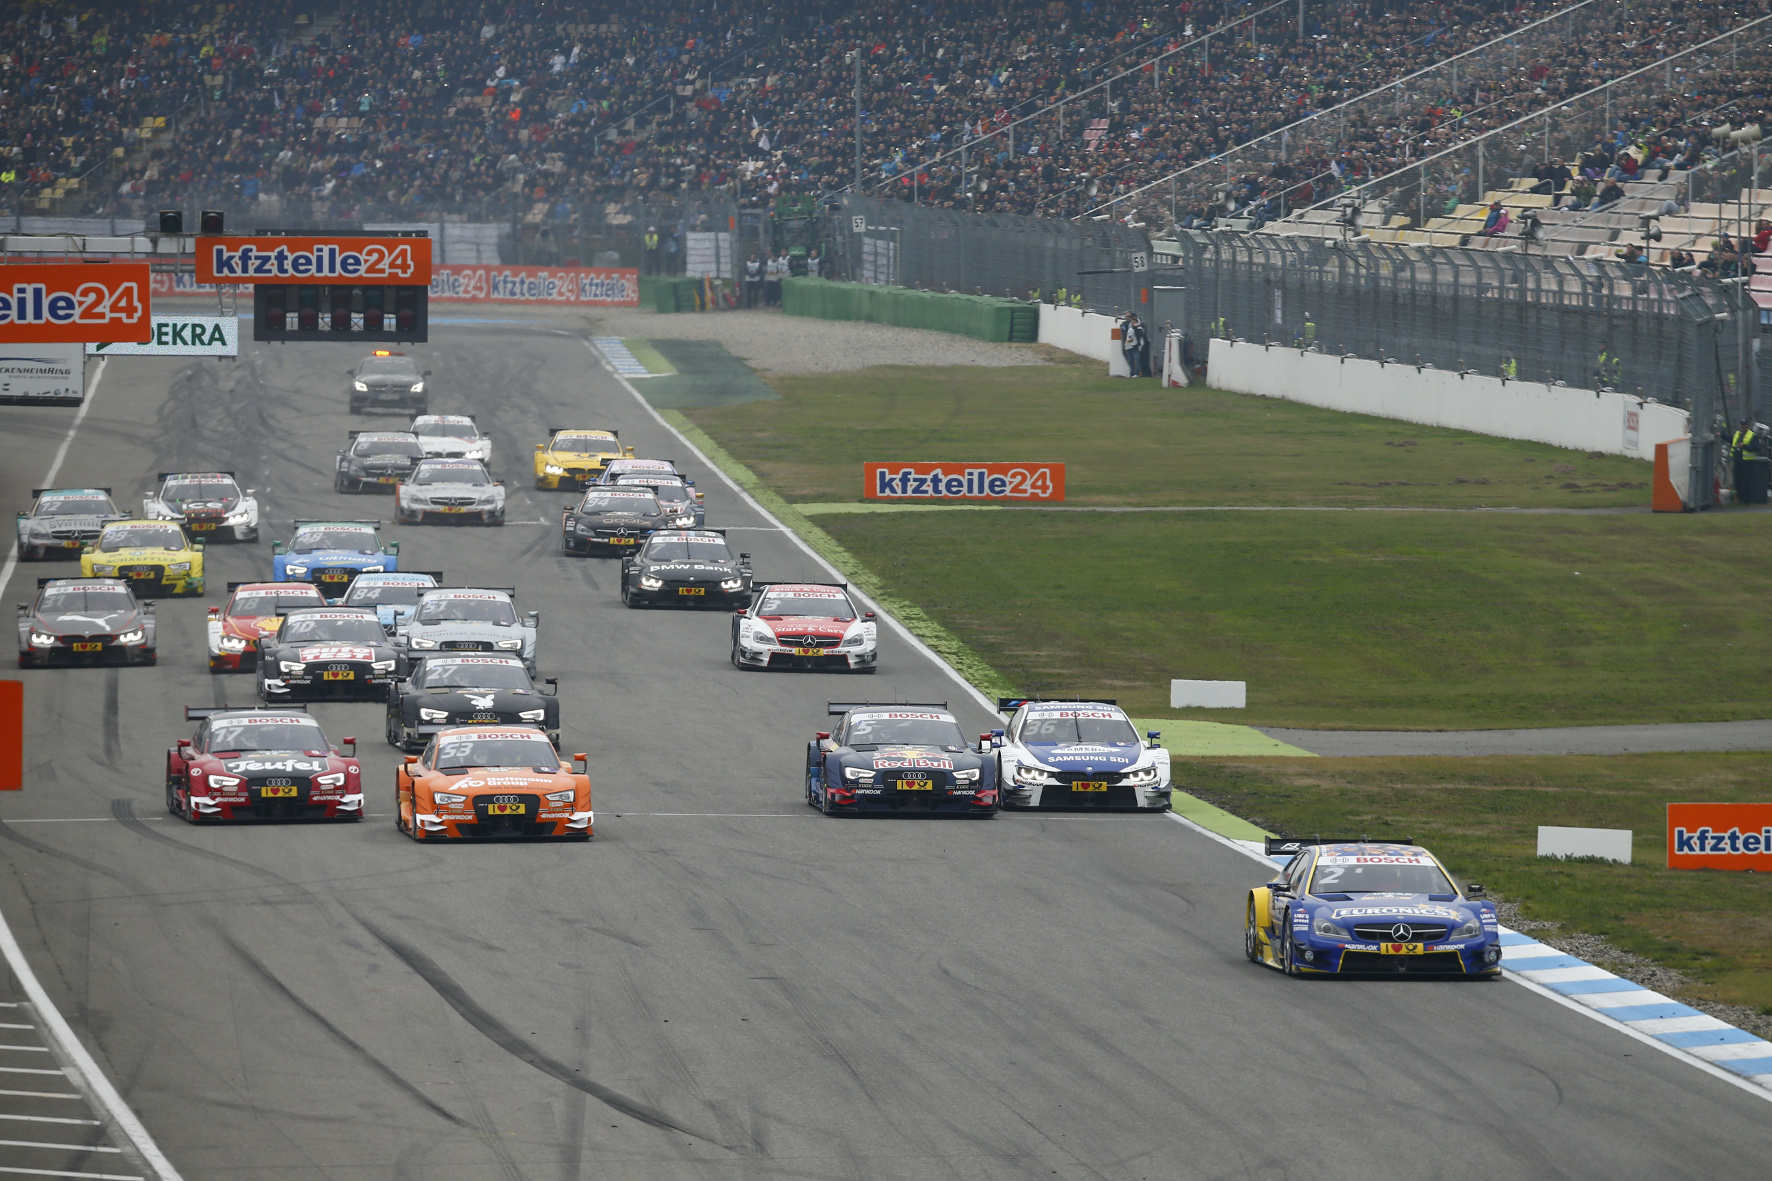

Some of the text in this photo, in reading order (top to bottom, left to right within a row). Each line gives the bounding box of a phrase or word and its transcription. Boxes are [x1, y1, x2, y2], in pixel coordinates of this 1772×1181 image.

[855, 217, 863, 228] 57
[213, 244, 414, 277] kfzteile24
[1134, 255, 1145, 268] 58
[490, 271, 577, 300] kfzteile24
[579, 273, 638, 301] kfzteile24
[140, 323, 227, 346] EKRA
[876, 468, 1053, 497] kfzteile24
[42, 502, 61, 511] 12
[104, 531, 128, 541] 99
[650, 564, 691, 572] BMW
[694, 564, 732, 573] Bank
[353, 588, 382, 600] 84
[236, 598, 260, 611] 18
[423, 601, 448, 613] 51
[763, 600, 781, 611] 3
[290, 620, 316, 633] 10
[818, 626, 846, 634] Cars
[426, 666, 459, 680] 27
[853, 720, 876, 735] 5
[1024, 720, 1057, 736] 36
[215, 727, 245, 743] 17
[441, 743, 474, 759] 53
[227, 759, 322, 772] Teufel
[873, 758, 953, 769] Red Bull
[1674, 826, 1772, 854] kfztei
[1318, 867, 1346, 884] 2
[1340, 907, 1447, 916] EURONICS
